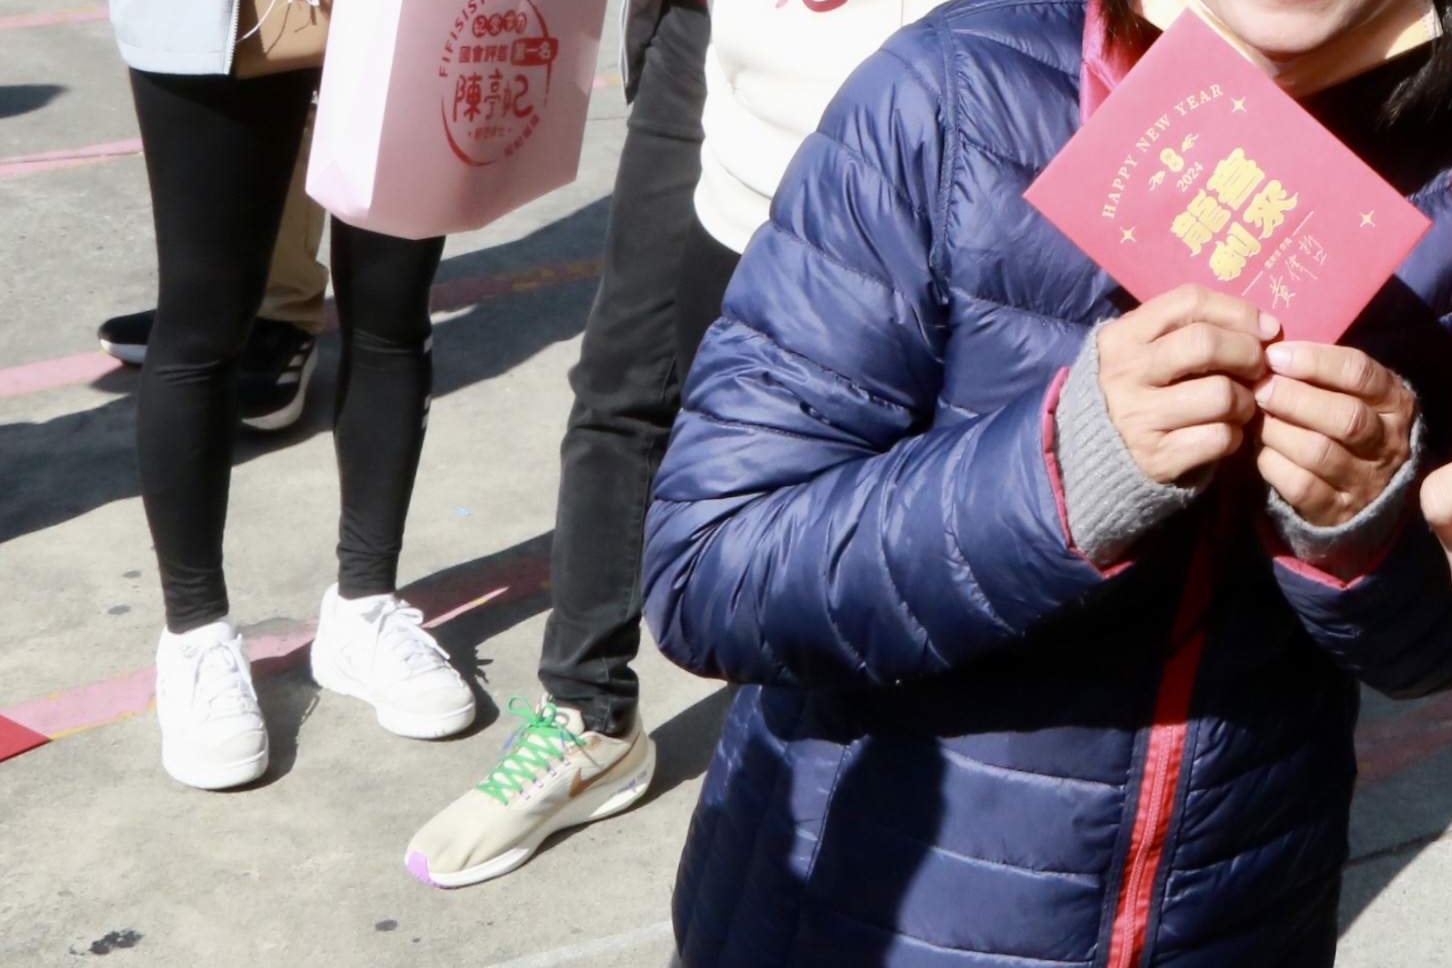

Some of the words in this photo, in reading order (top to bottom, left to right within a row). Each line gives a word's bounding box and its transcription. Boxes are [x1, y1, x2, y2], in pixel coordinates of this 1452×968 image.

[453, 69, 534, 123] 陳亭妃
[1102, 154, 1138, 219] HAPPY
[1136, 114, 1171, 153] NEW
[1174, 84, 1223, 116] YEAR
[1177, 161, 1204, 192] 2024
